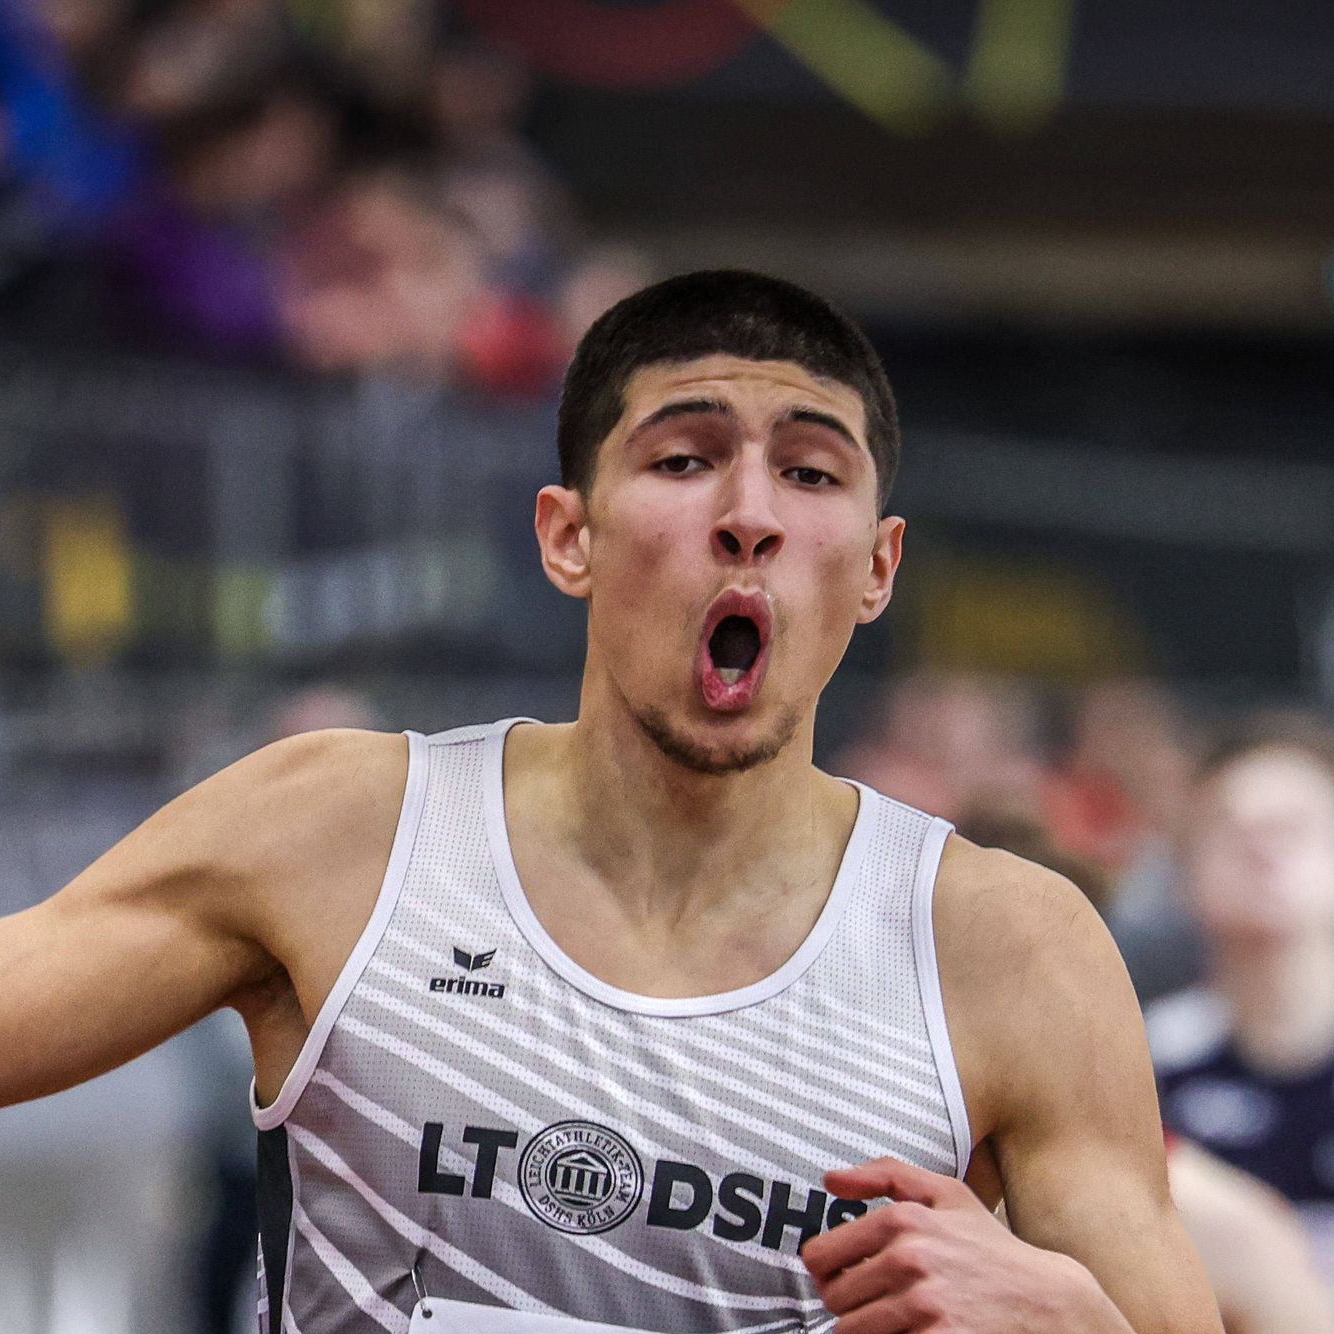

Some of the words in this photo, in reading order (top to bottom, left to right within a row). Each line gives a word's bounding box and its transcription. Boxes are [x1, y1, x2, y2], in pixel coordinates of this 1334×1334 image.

[429, 976, 505, 999] erima
[418, 1122, 518, 1200] LT
[538, 1194, 574, 1224] DSHS
[576, 1205, 616, 1229] KÖLN
